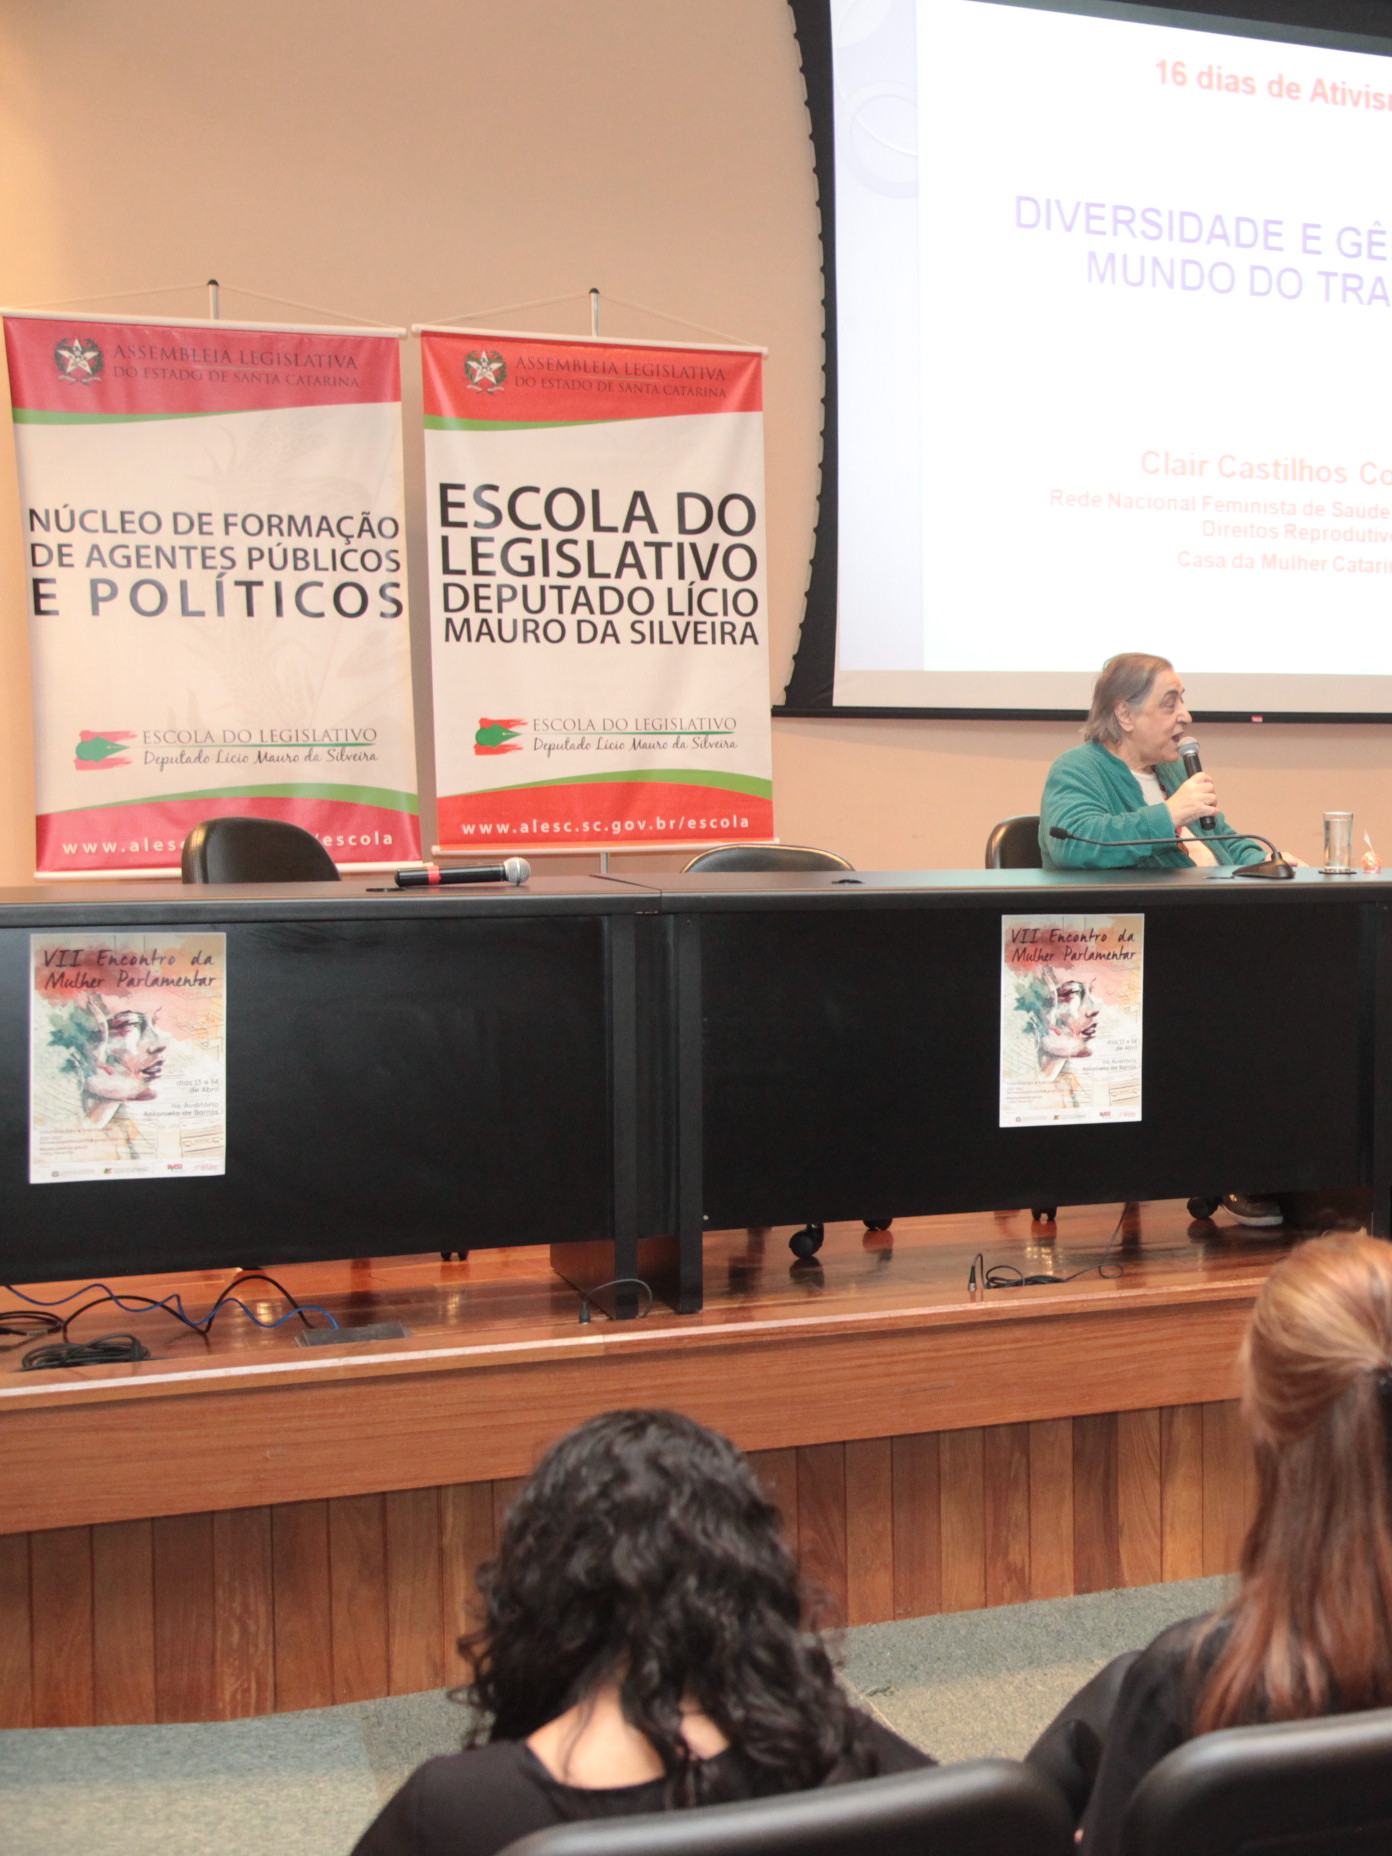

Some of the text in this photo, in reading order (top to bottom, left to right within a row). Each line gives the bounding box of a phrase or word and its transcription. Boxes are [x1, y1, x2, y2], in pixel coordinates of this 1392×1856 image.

[1155, 58, 1187, 87] 16
[1197, 64, 1257, 96] dias
[1267, 73, 1302, 101] de
[1015, 195, 1285, 253] DIVERSIDADE
[1302, 222, 1323, 256] E
[1086, 250, 1236, 294] MUNDO
[1249, 264, 1303, 301] DO
[113, 344, 358, 370] ASSEMBLEIA LEGISLATIVA
[515, 356, 726, 381] ASSEMBLEIA LEGISLATIVA
[113, 365, 138, 379] DO
[143, 367, 202, 381] ESTADO
[208, 370, 229, 383] DE
[233, 371, 281, 386] SANTA
[285, 373, 359, 388] CATARINA
[515, 376, 727, 399] DO ESTADO DE SANTA CATARINA
[1140, 450, 1208, 480] Clair
[1217, 453, 1349, 486] Castilhos
[439, 482, 757, 537] ESCOLA DO
[1049, 488, 1102, 509] Rede
[1108, 490, 1196, 513] Nacional
[1202, 495, 1297, 517] Feminista
[1303, 499, 1326, 518] de
[29, 503, 400, 545] NÚCLEO DE FORMAÇÃO
[1202, 519, 1279, 541] Direitos
[30, 542, 401, 573] DE AGENTES PÚBLICOS
[441, 535, 758, 582] LEGISLATIVO
[1177, 551, 1227, 571] Casa
[1232, 552, 1256, 571] da
[1261, 552, 1328, 574] Mulher
[32, 572, 404, 619] E POLÍTICOS
[442, 580, 759, 618] DEPUTADO LÍCIO
[444, 617, 759, 646] MAURO DA SILVEIRA
[143, 727, 378, 745] ESCOLA DO LEGISLATIVO
[533, 716, 737, 732] ESCOLA DO LEGISLATIVO
[533, 736, 592, 758] Deputado
[628, 736, 668, 752] Mauro
[672, 735, 688, 750] da
[692, 734, 738, 750] Silveira
[143, 748, 211, 773] Deputado
[252, 749, 299, 765] Mauro
[304, 748, 322, 763] da
[326, 746, 379, 763] Silveira
[462, 814, 750, 836] www.alesc.sc.gov.br/escola
[1011, 928, 1135, 944] VII Encontro da
[43, 948, 214, 968] VII Encontro da
[1012, 945, 1137, 963] Mulher Parlamentar
[45, 969, 216, 990] Mulher Parlamentar
[201, 1085, 219, 1093] Abril
